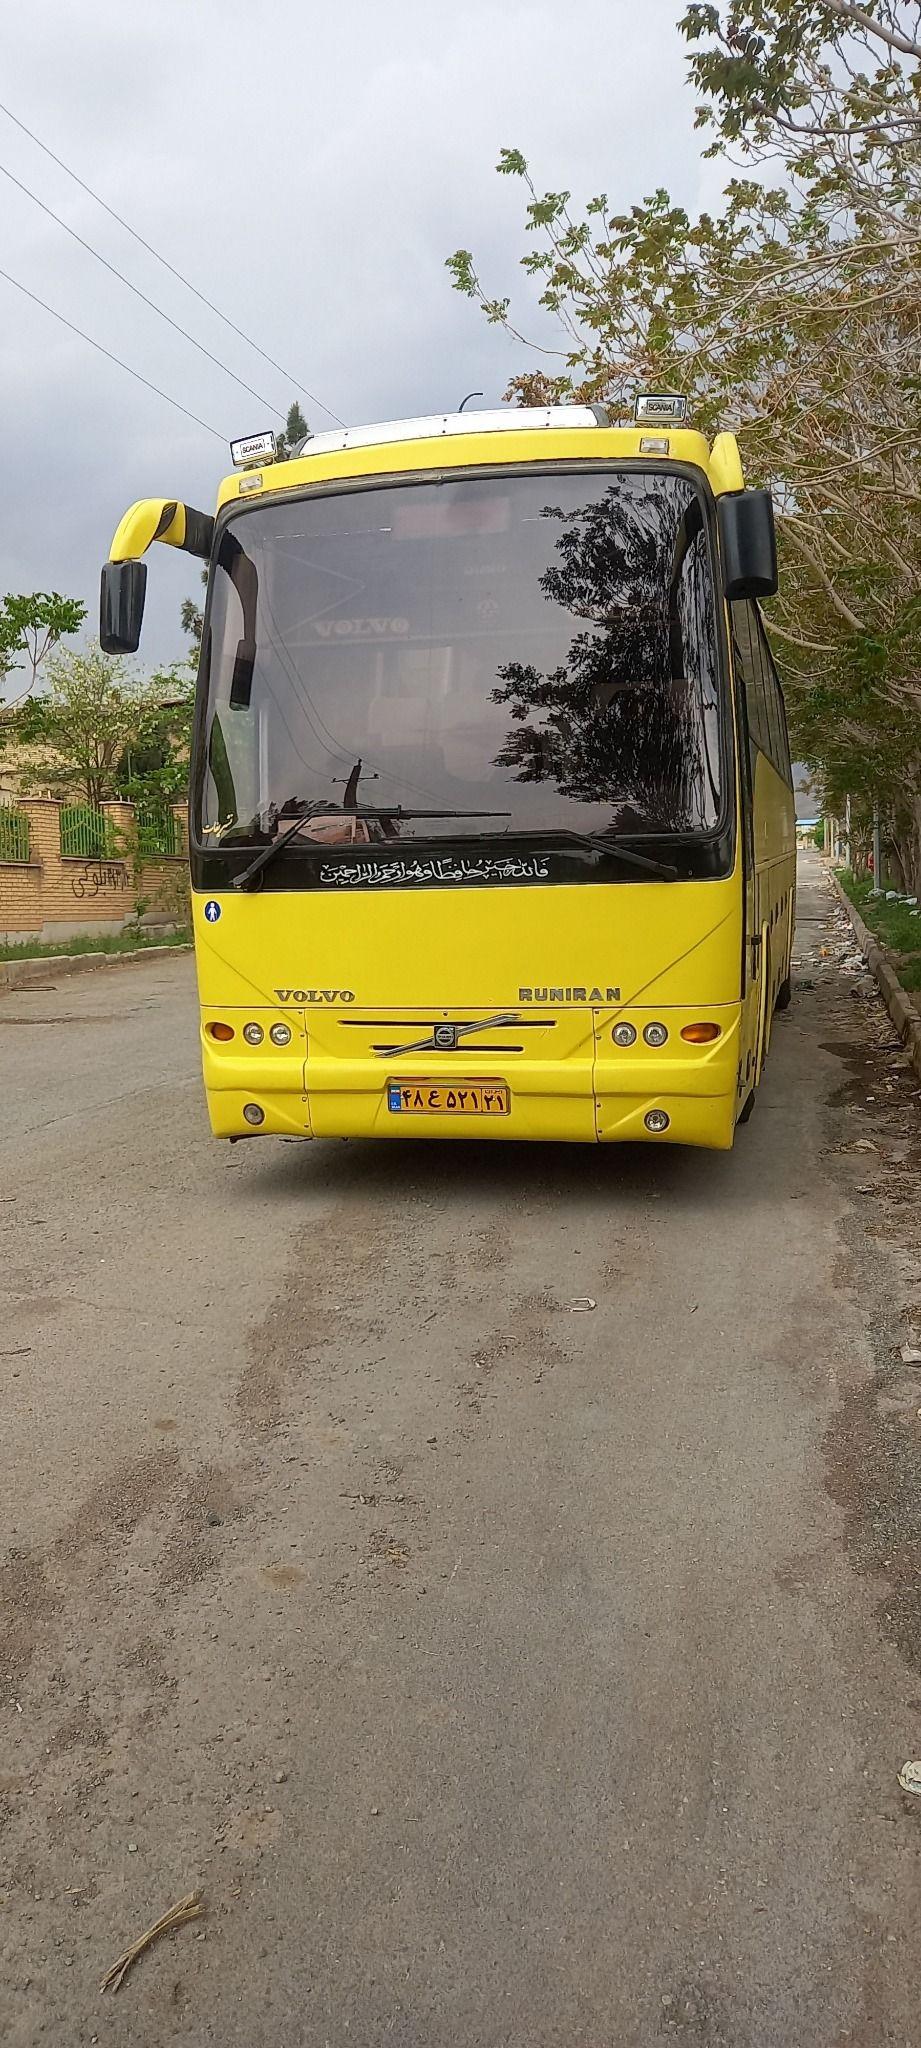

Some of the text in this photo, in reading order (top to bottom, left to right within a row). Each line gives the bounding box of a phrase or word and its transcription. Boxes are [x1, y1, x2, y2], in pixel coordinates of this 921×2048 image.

[648, 403, 673, 412] SCANIA
[242, 442, 264, 454] SCANIA
[310, 617, 410, 637] VOLVO
[274, 989, 355, 1003] VOLVO
[518, 987, 621, 1001] RUNIRAN
